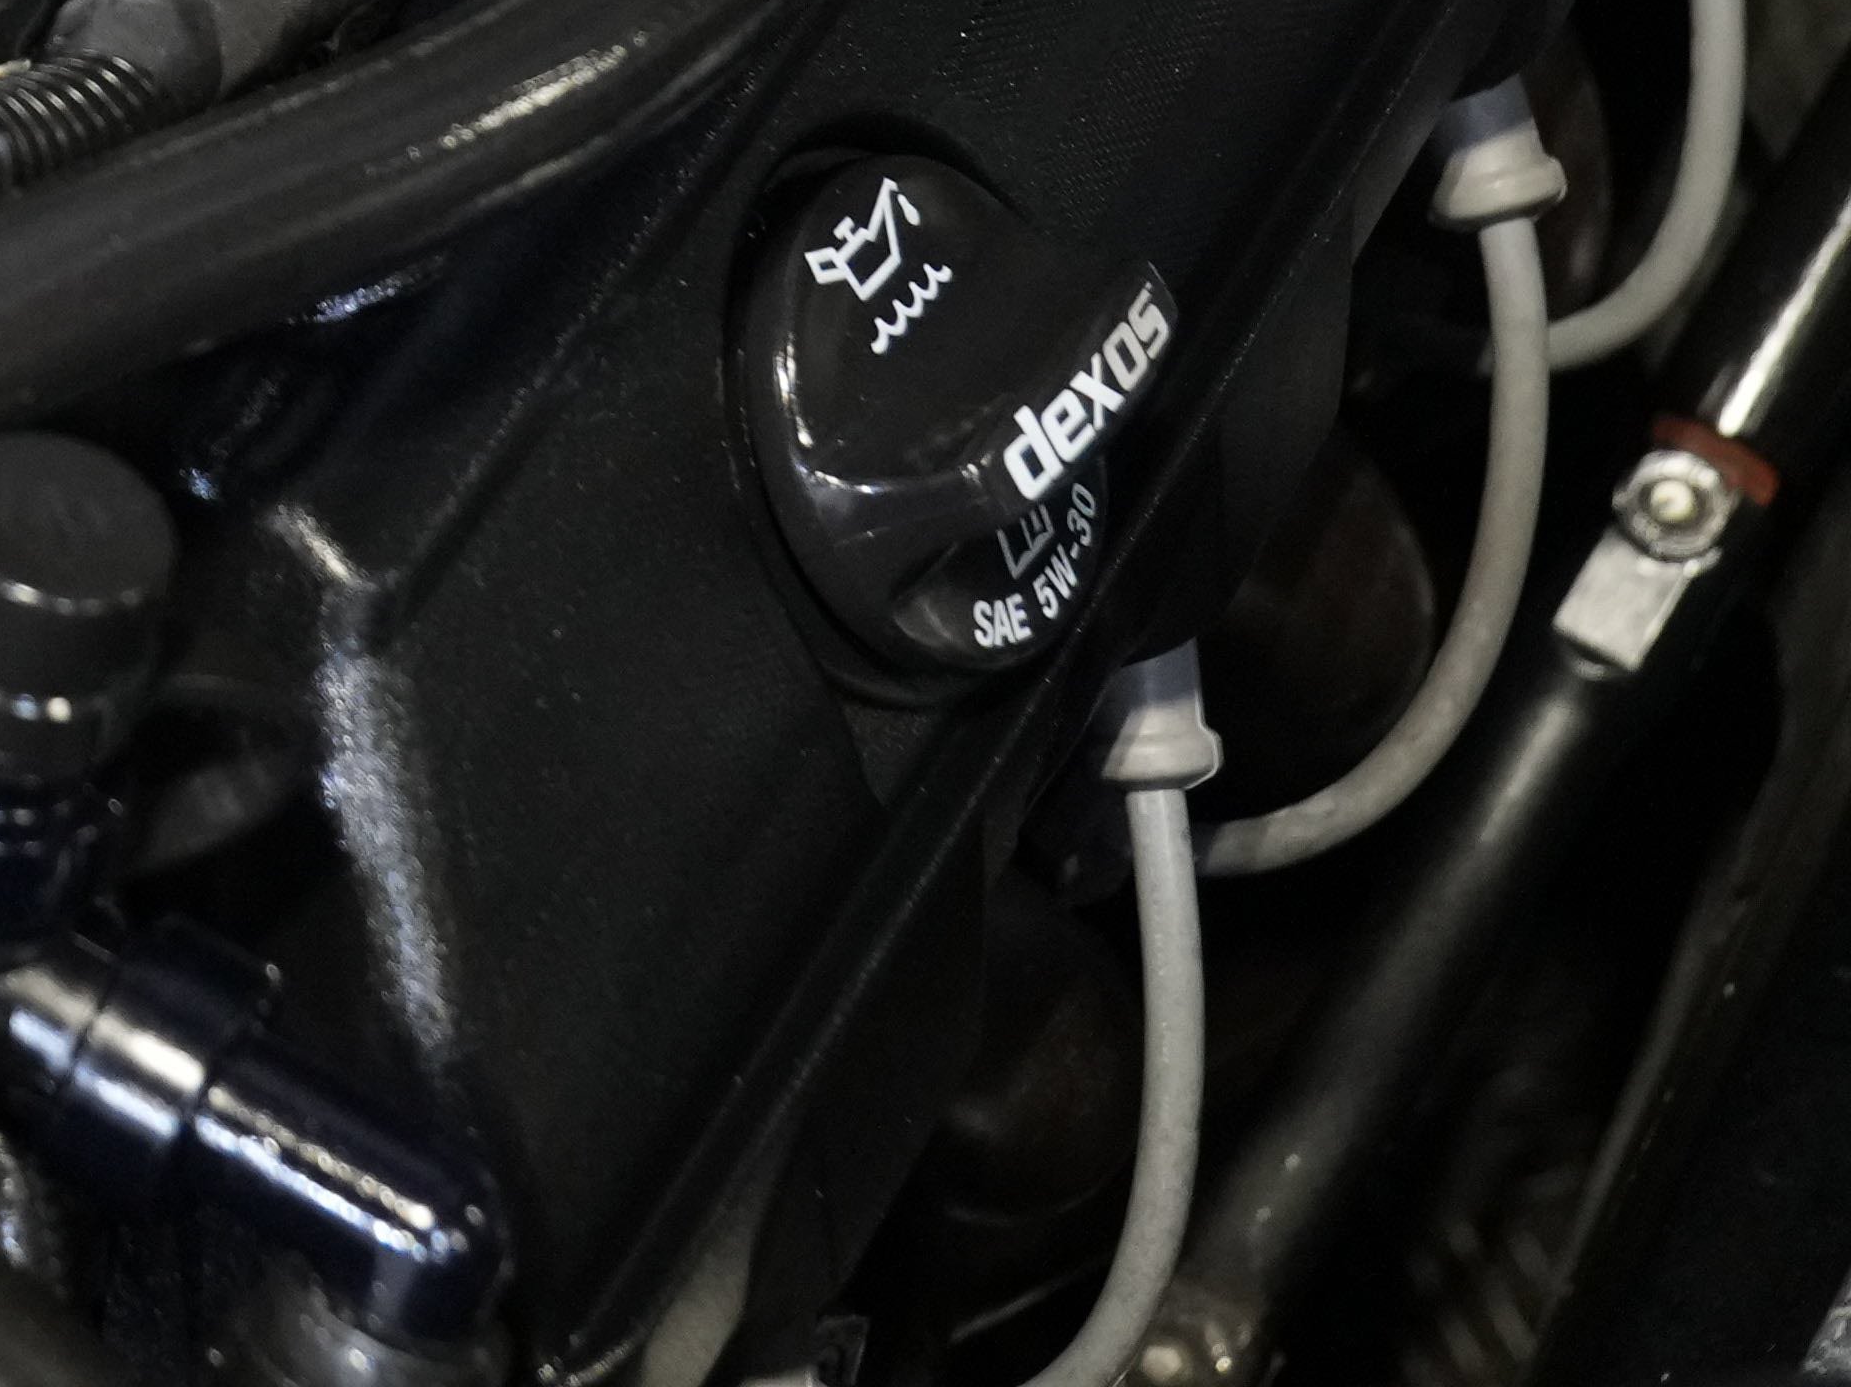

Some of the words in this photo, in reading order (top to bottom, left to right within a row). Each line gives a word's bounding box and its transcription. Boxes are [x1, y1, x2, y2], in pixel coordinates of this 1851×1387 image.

[1002, 280, 1170, 501] dexos
[972, 592, 1033, 648] SAE
[1032, 481, 1096, 619] 5W-30
